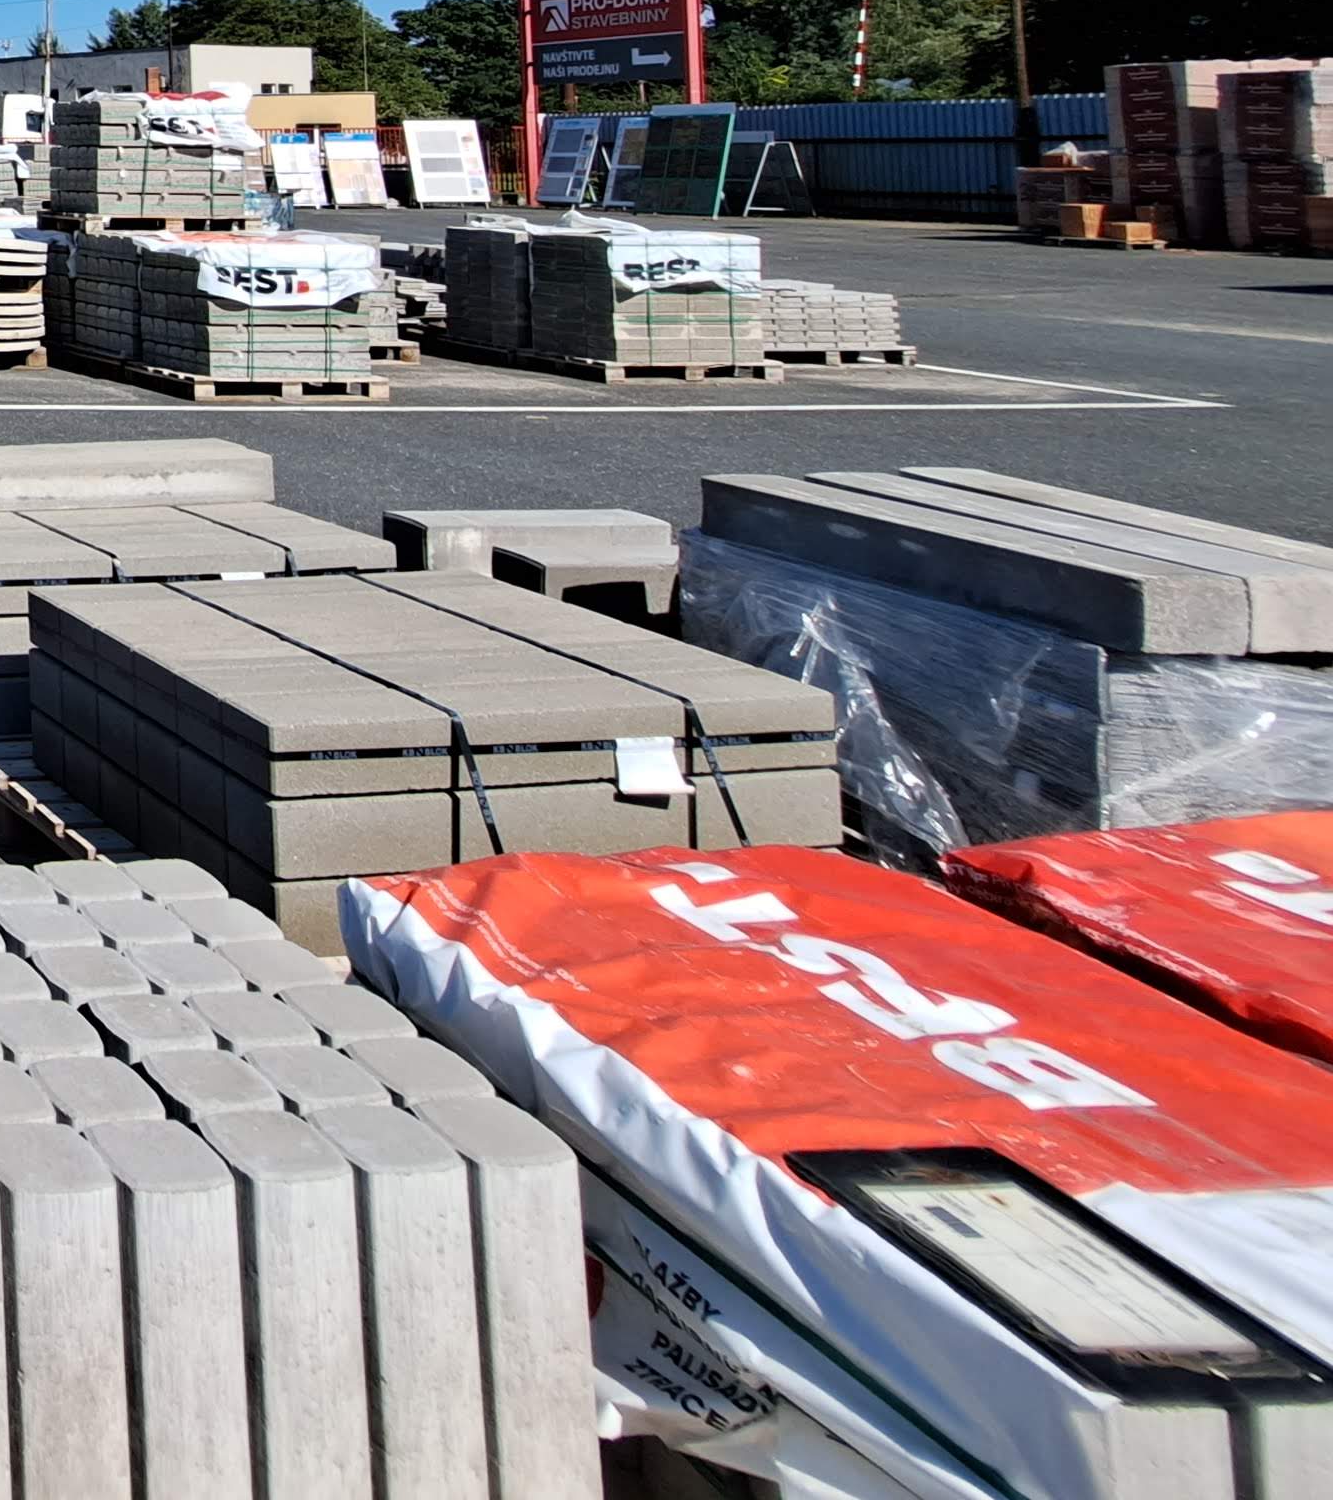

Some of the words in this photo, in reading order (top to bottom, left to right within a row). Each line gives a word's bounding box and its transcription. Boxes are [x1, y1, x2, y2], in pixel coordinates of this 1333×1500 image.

[571, 8, 670, 29] STAVEBNINY
[542, 49, 596, 63] NAVŠTIVTE
[543, 65, 566, 78] NAŠI
[567, 63, 620, 77] PRODEJNU
[648, 882, 1159, 1112] BEST
[633, 1235, 723, 1323] LAŽBY
[623, 1357, 731, 1432] ZTRACE
